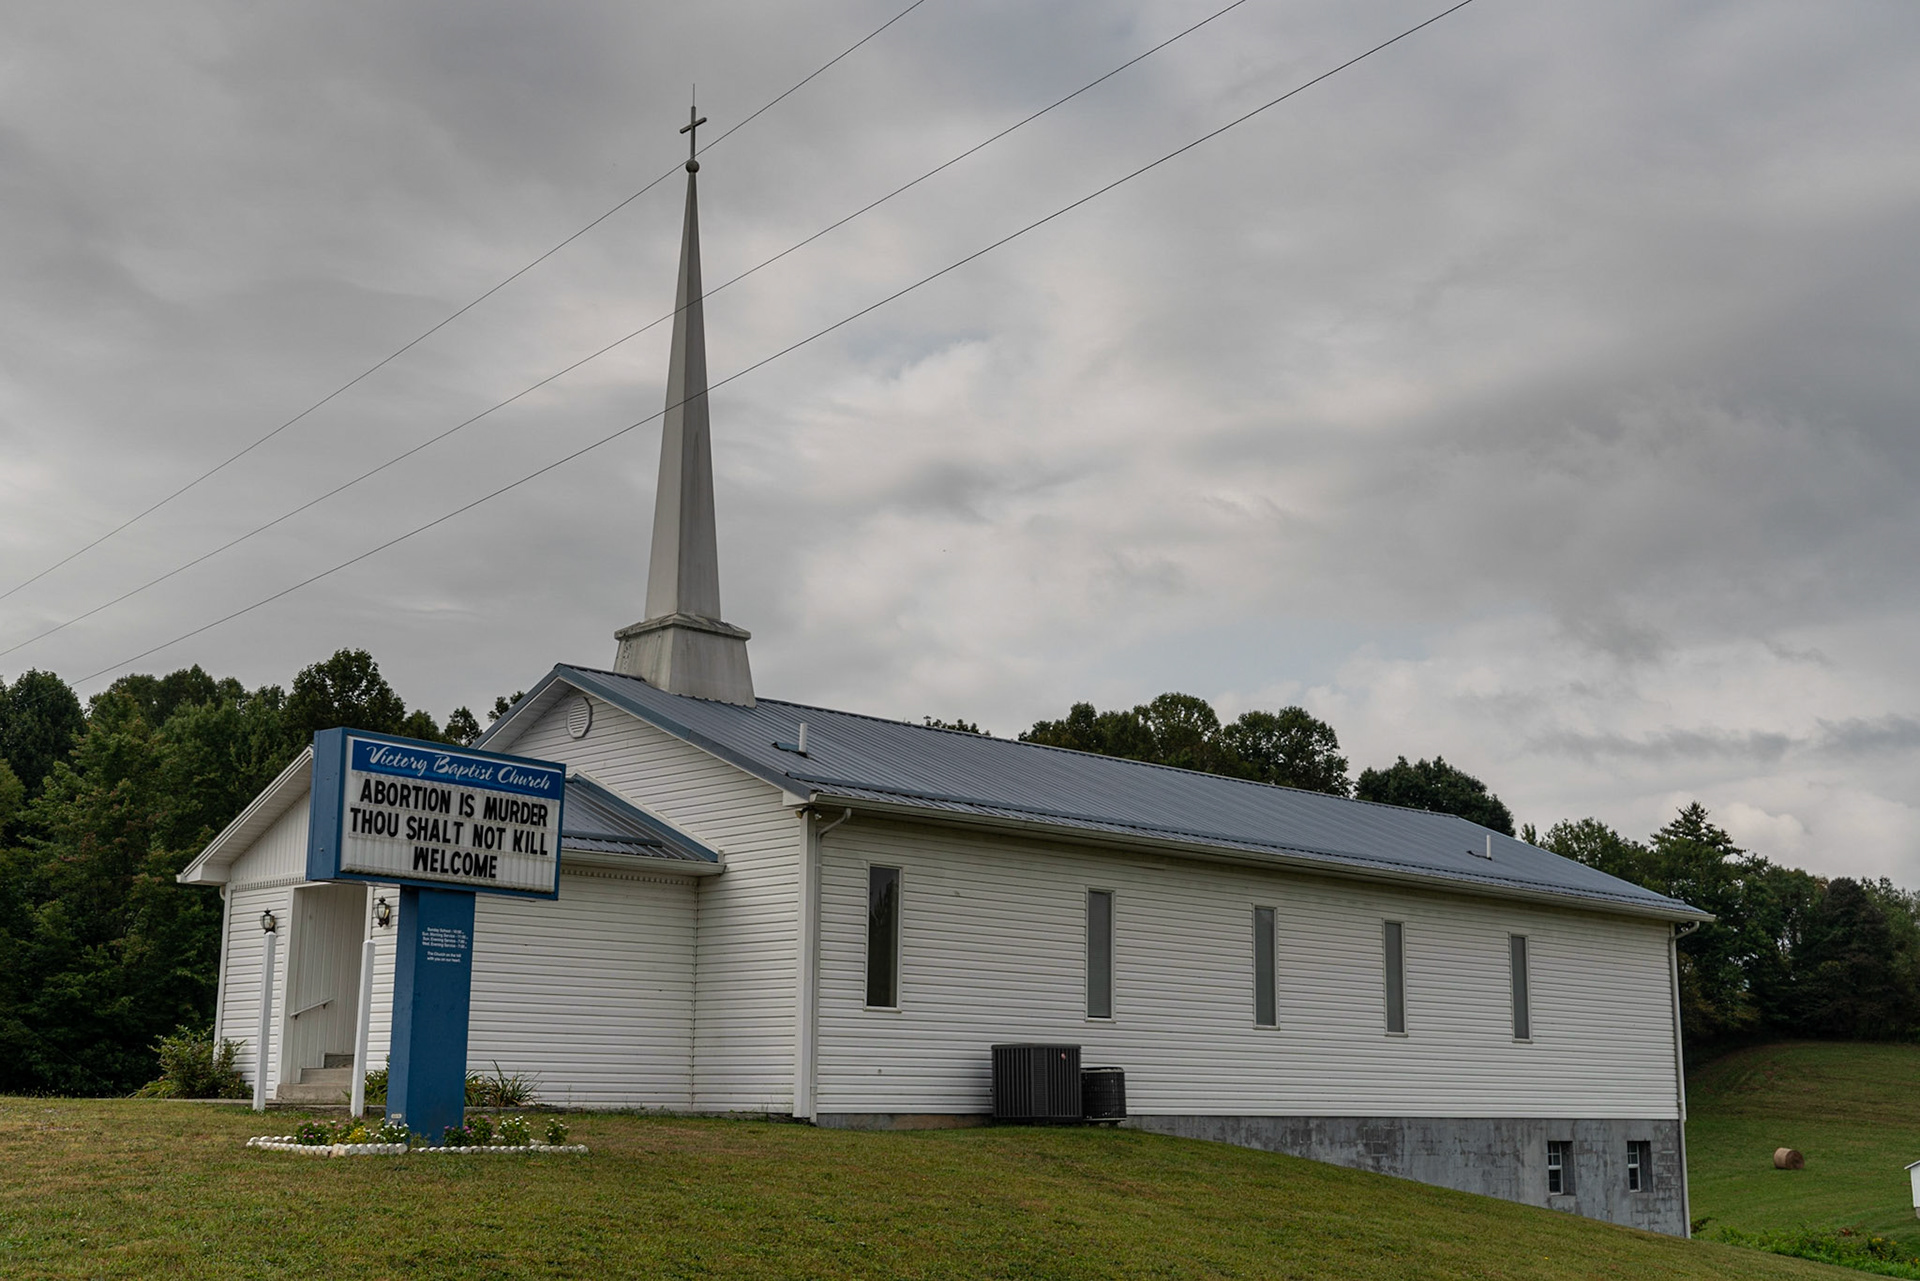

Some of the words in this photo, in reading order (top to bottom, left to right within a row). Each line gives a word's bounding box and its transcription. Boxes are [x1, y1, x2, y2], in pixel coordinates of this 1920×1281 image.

[366, 746, 428, 777] Victory
[432, 754, 493, 781] Baptist
[497, 765, 550, 790] Church
[360, 778, 451, 814] ABORTION
[458, 792, 475, 818] IS
[483, 796, 548, 827] MURDER
[350, 807, 399, 837] THOU
[406, 816, 464, 845] SHALT
[472, 824, 506, 850] NOT
[512, 829, 548, 856] KILL
[413, 846, 498, 879] WELCOME
